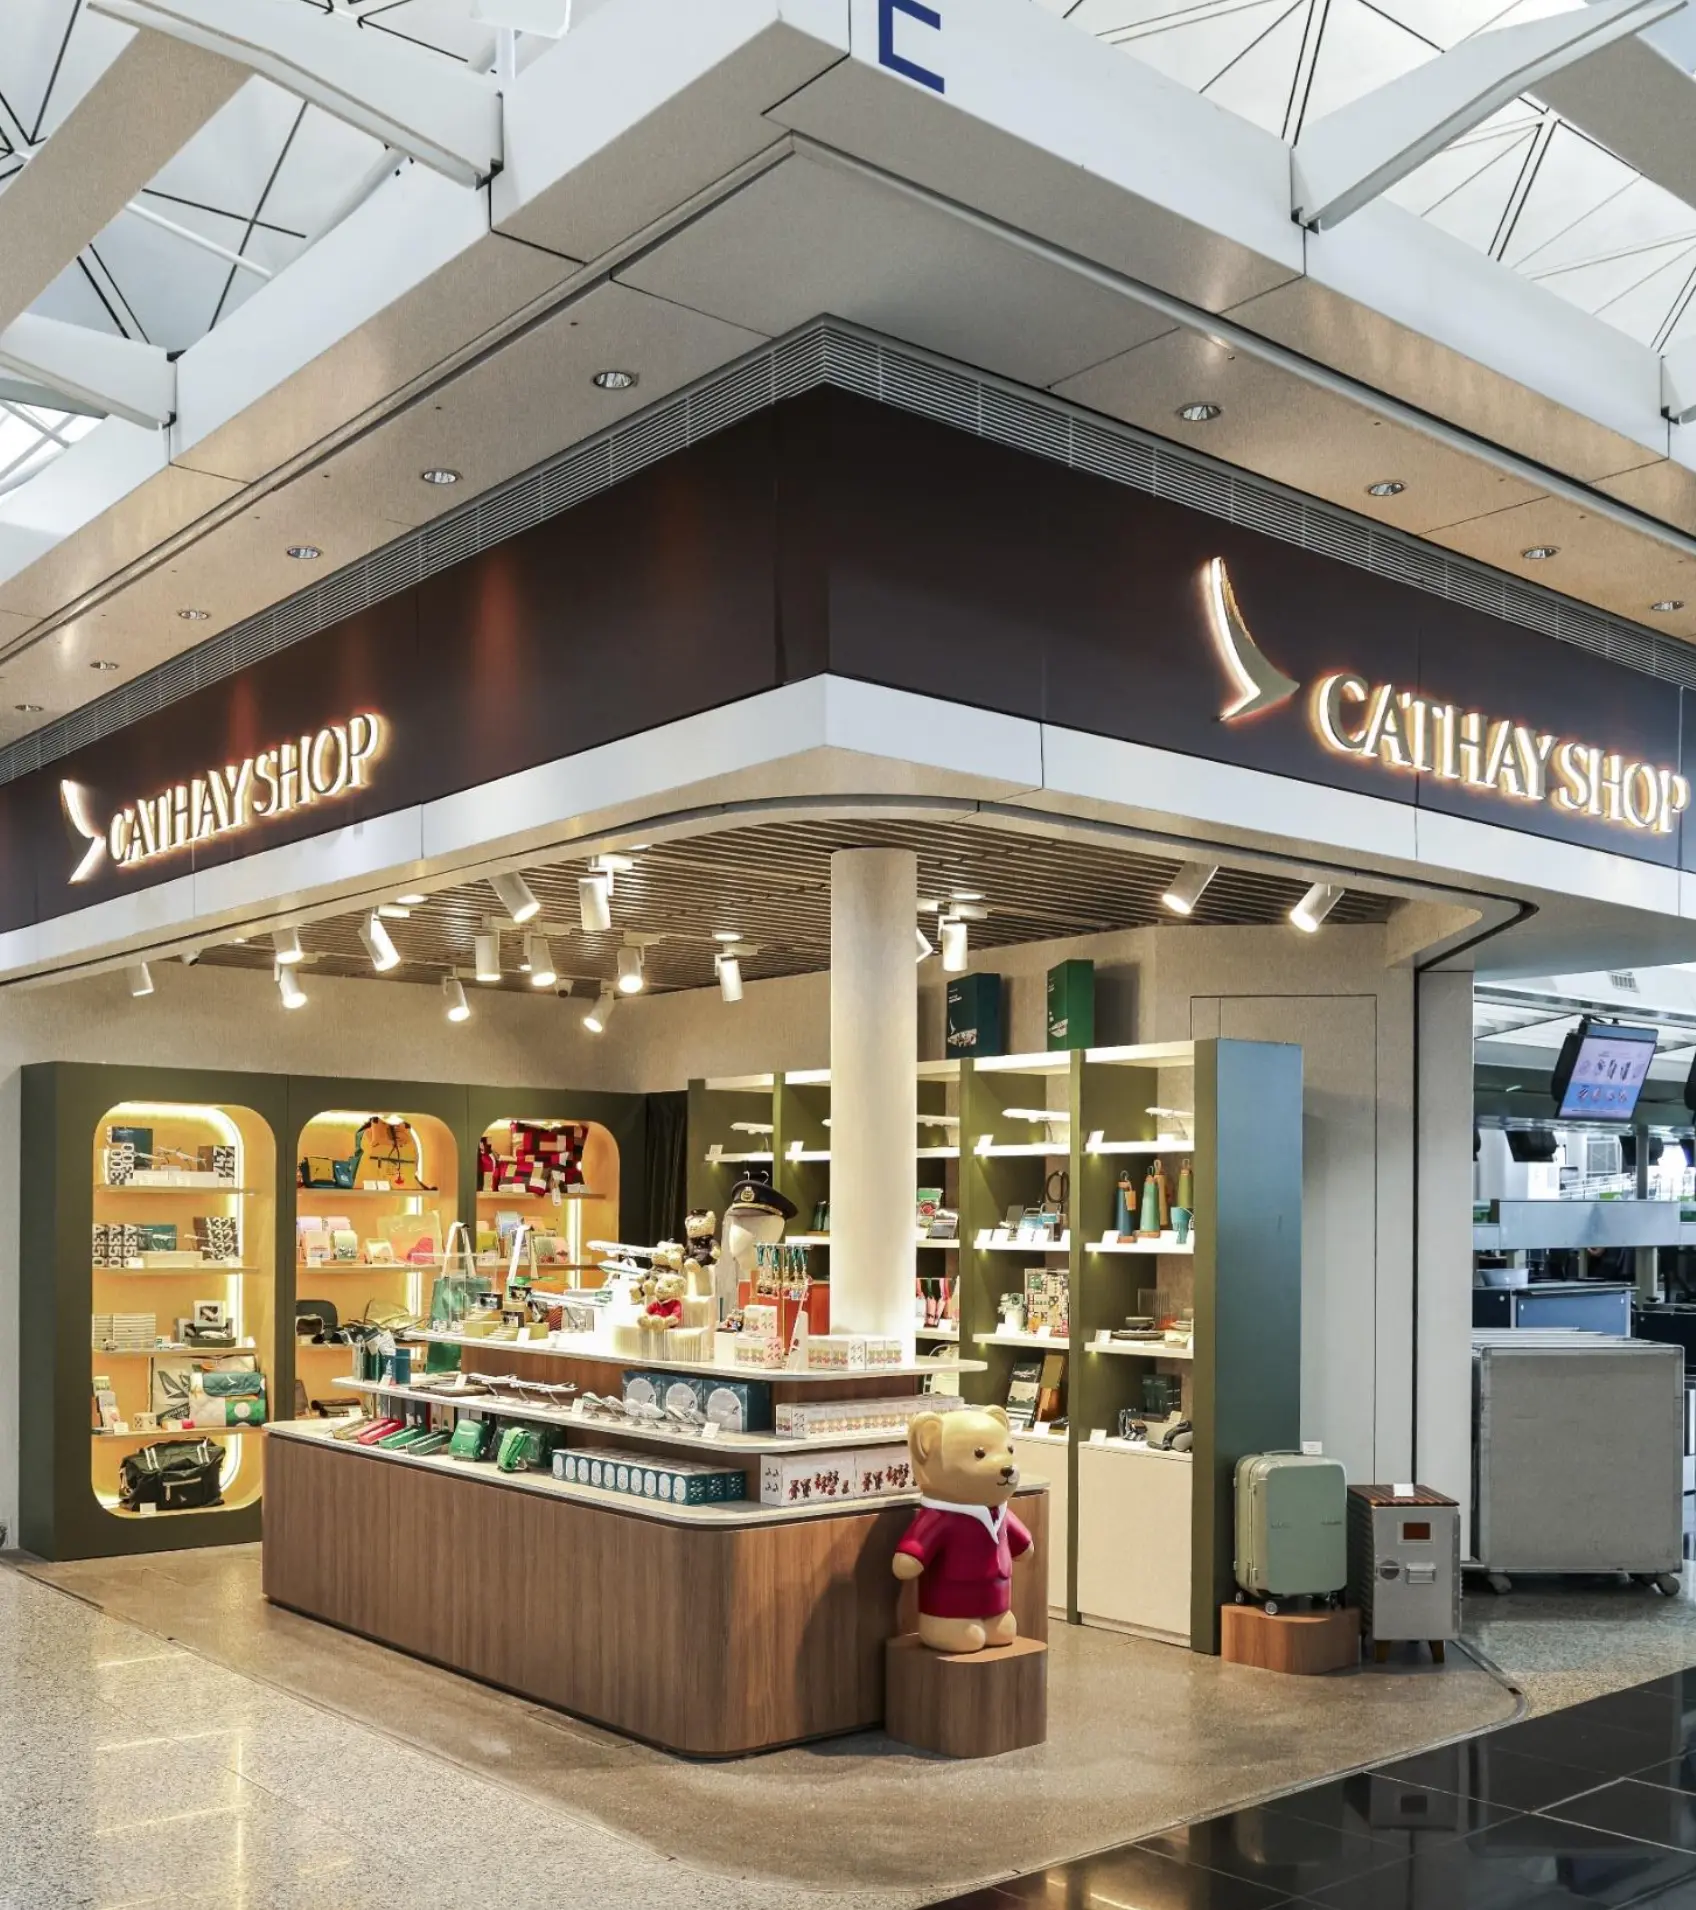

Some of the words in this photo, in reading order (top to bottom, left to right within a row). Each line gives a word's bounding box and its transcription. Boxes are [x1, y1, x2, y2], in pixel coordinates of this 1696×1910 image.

[110, 758, 254, 867] CATHAY
[252, 713, 379, 817] SHOP
[1318, 673, 1559, 800] CATHAY
[1557, 742, 1691, 833] SHOP
